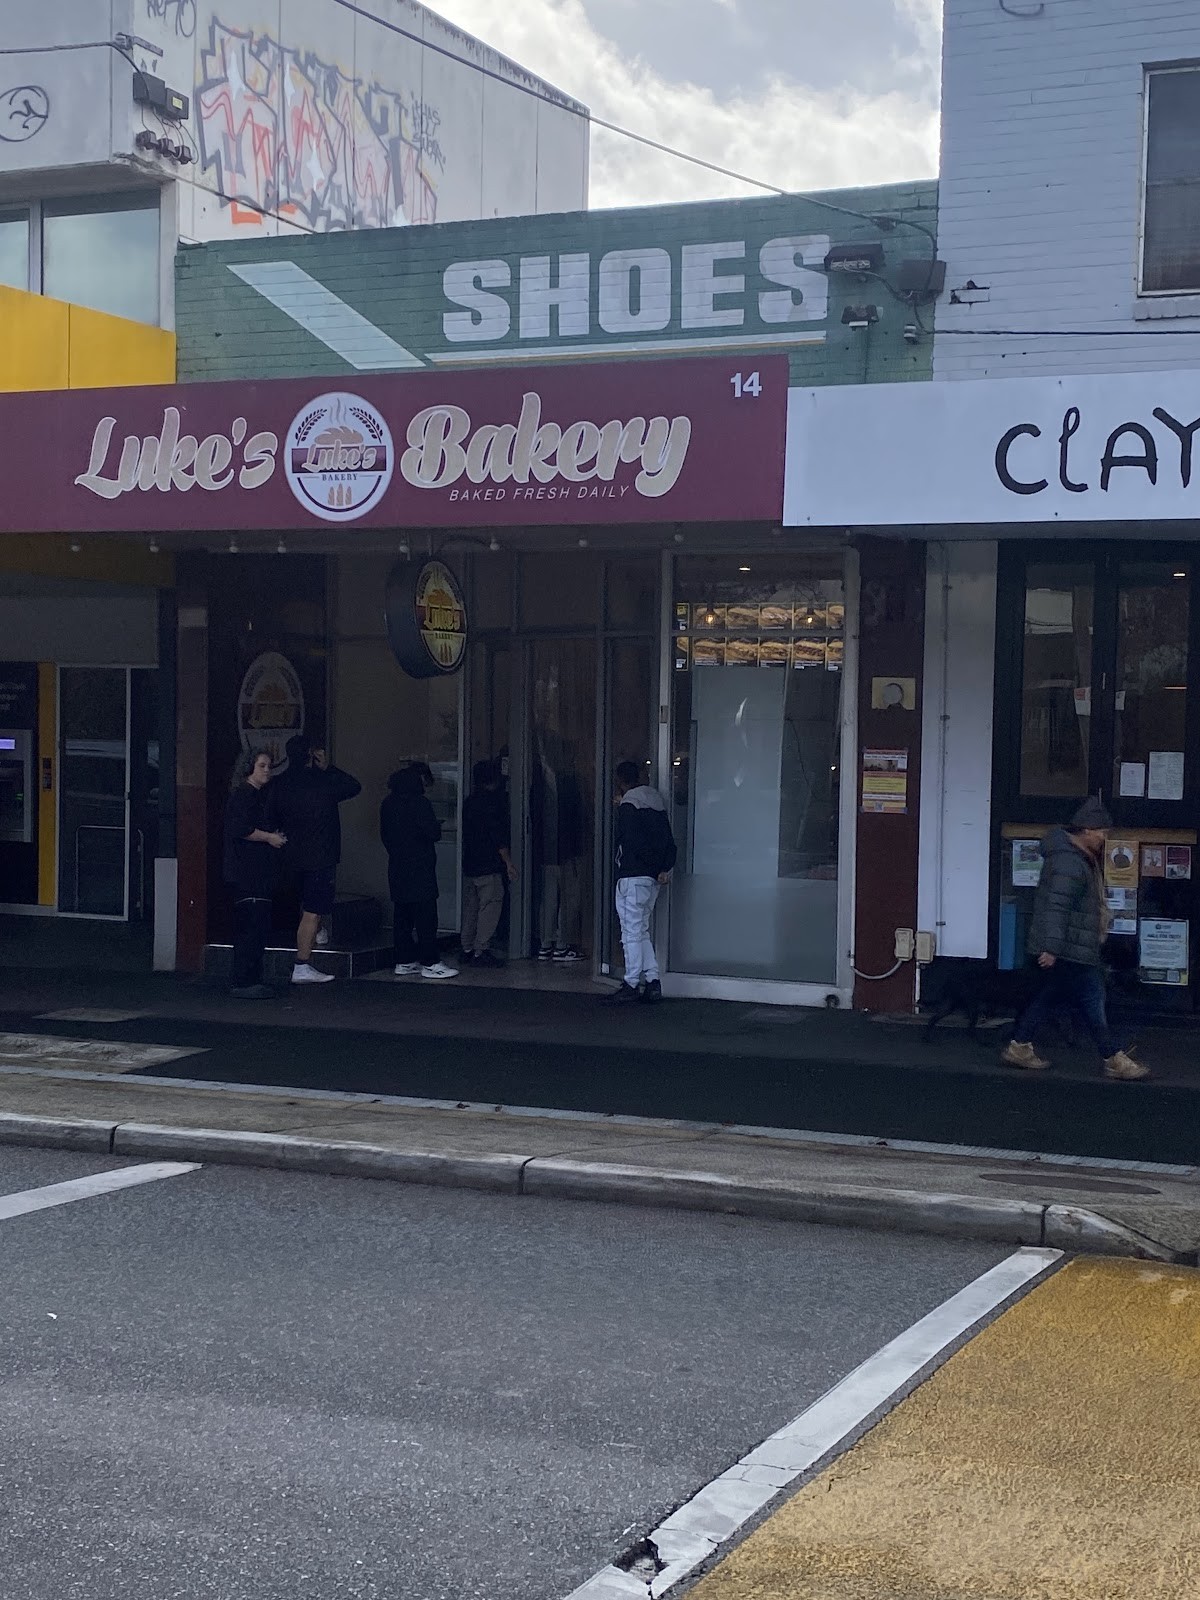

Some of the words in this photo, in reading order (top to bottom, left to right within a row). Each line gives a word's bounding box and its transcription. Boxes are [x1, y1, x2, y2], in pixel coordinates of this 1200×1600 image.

[443, 234, 830, 342] SHOES
[730, 372, 762, 398] 14
[74, 406, 278, 499] Luke's
[400, 391, 691, 497] Bakery
[301, 439, 377, 473] Luke's
[321, 473, 358, 481] BAKERY
[449, 488, 506, 501] BAKED
[513, 486, 570, 500] FRESH
[577, 485, 630, 499] DAILY
